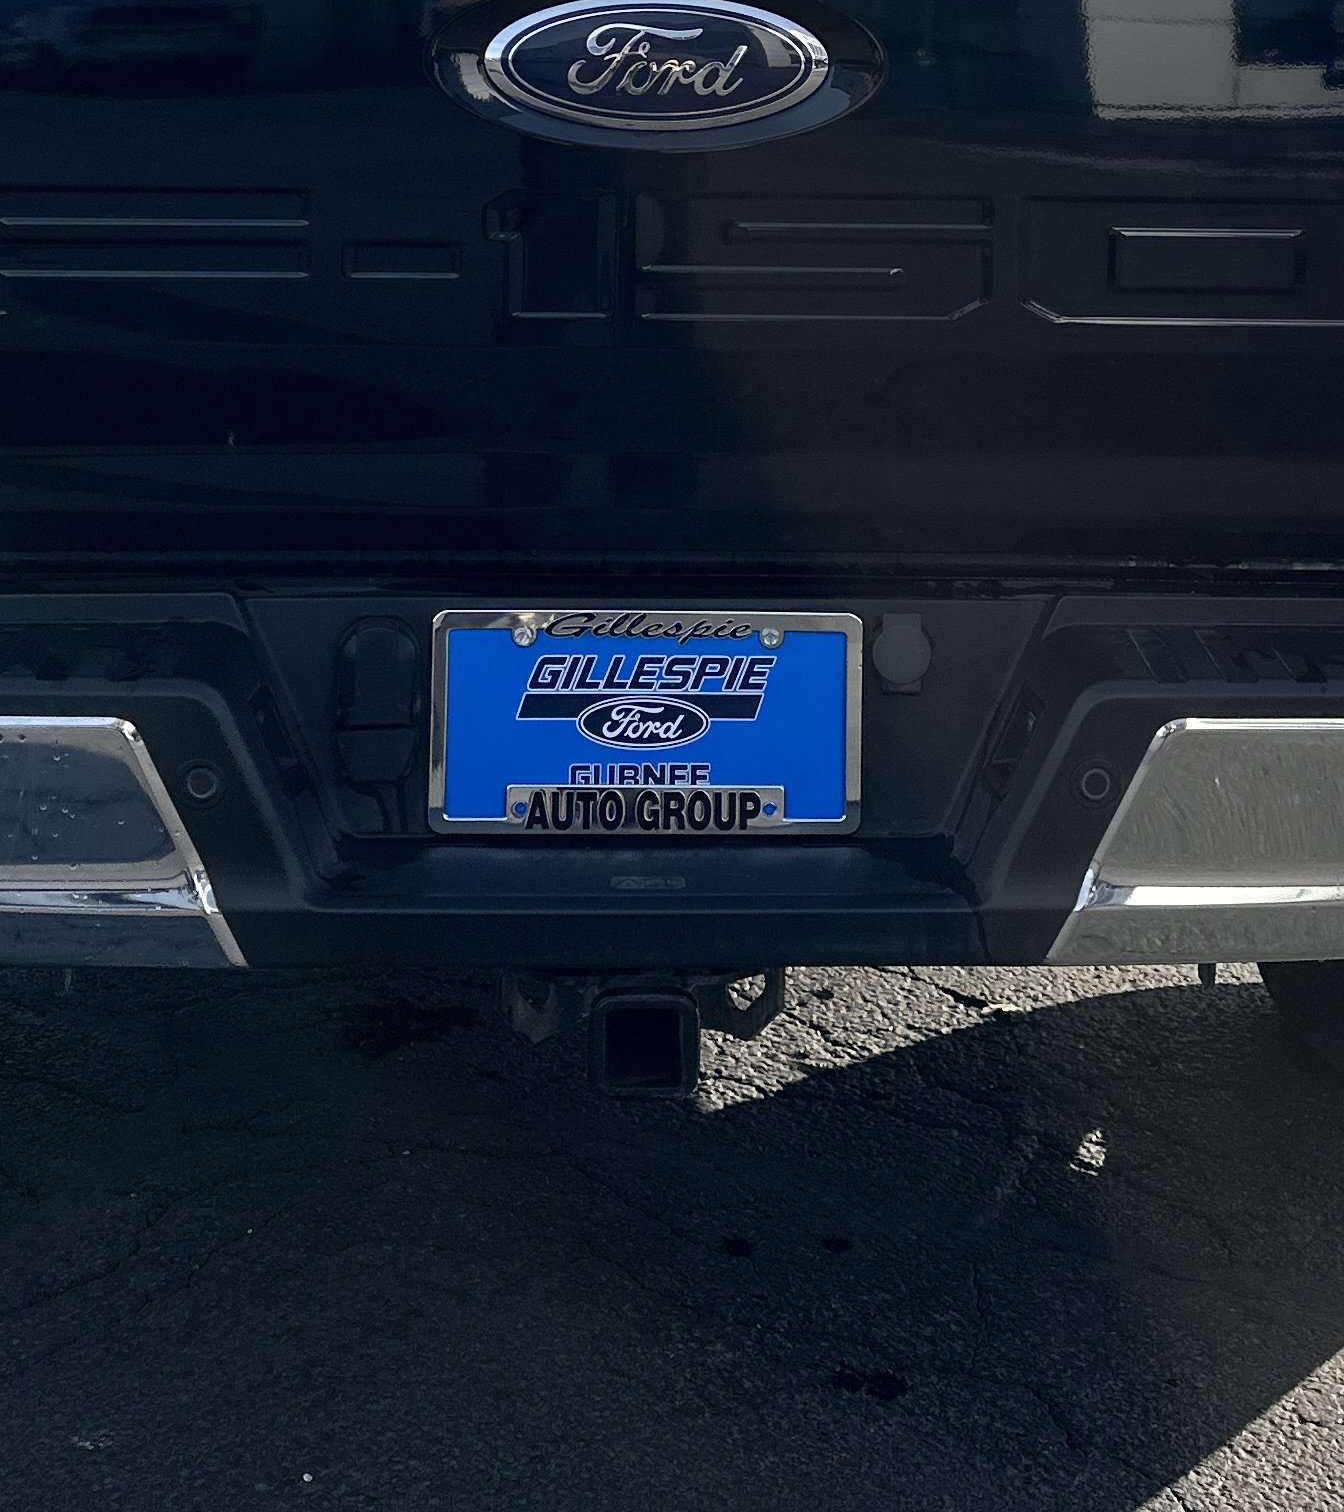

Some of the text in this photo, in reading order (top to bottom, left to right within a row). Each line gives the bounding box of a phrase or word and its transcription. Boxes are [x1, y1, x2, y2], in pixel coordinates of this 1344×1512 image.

[567, 22, 748, 96] Ford
[544, 611, 752, 647] Gillespie
[527, 654, 777, 692] GILLESPIE
[602, 704, 686, 739] Ford
[568, 762, 712, 785] GURNEE
[524, 789, 762, 830] AUTO GROUP
